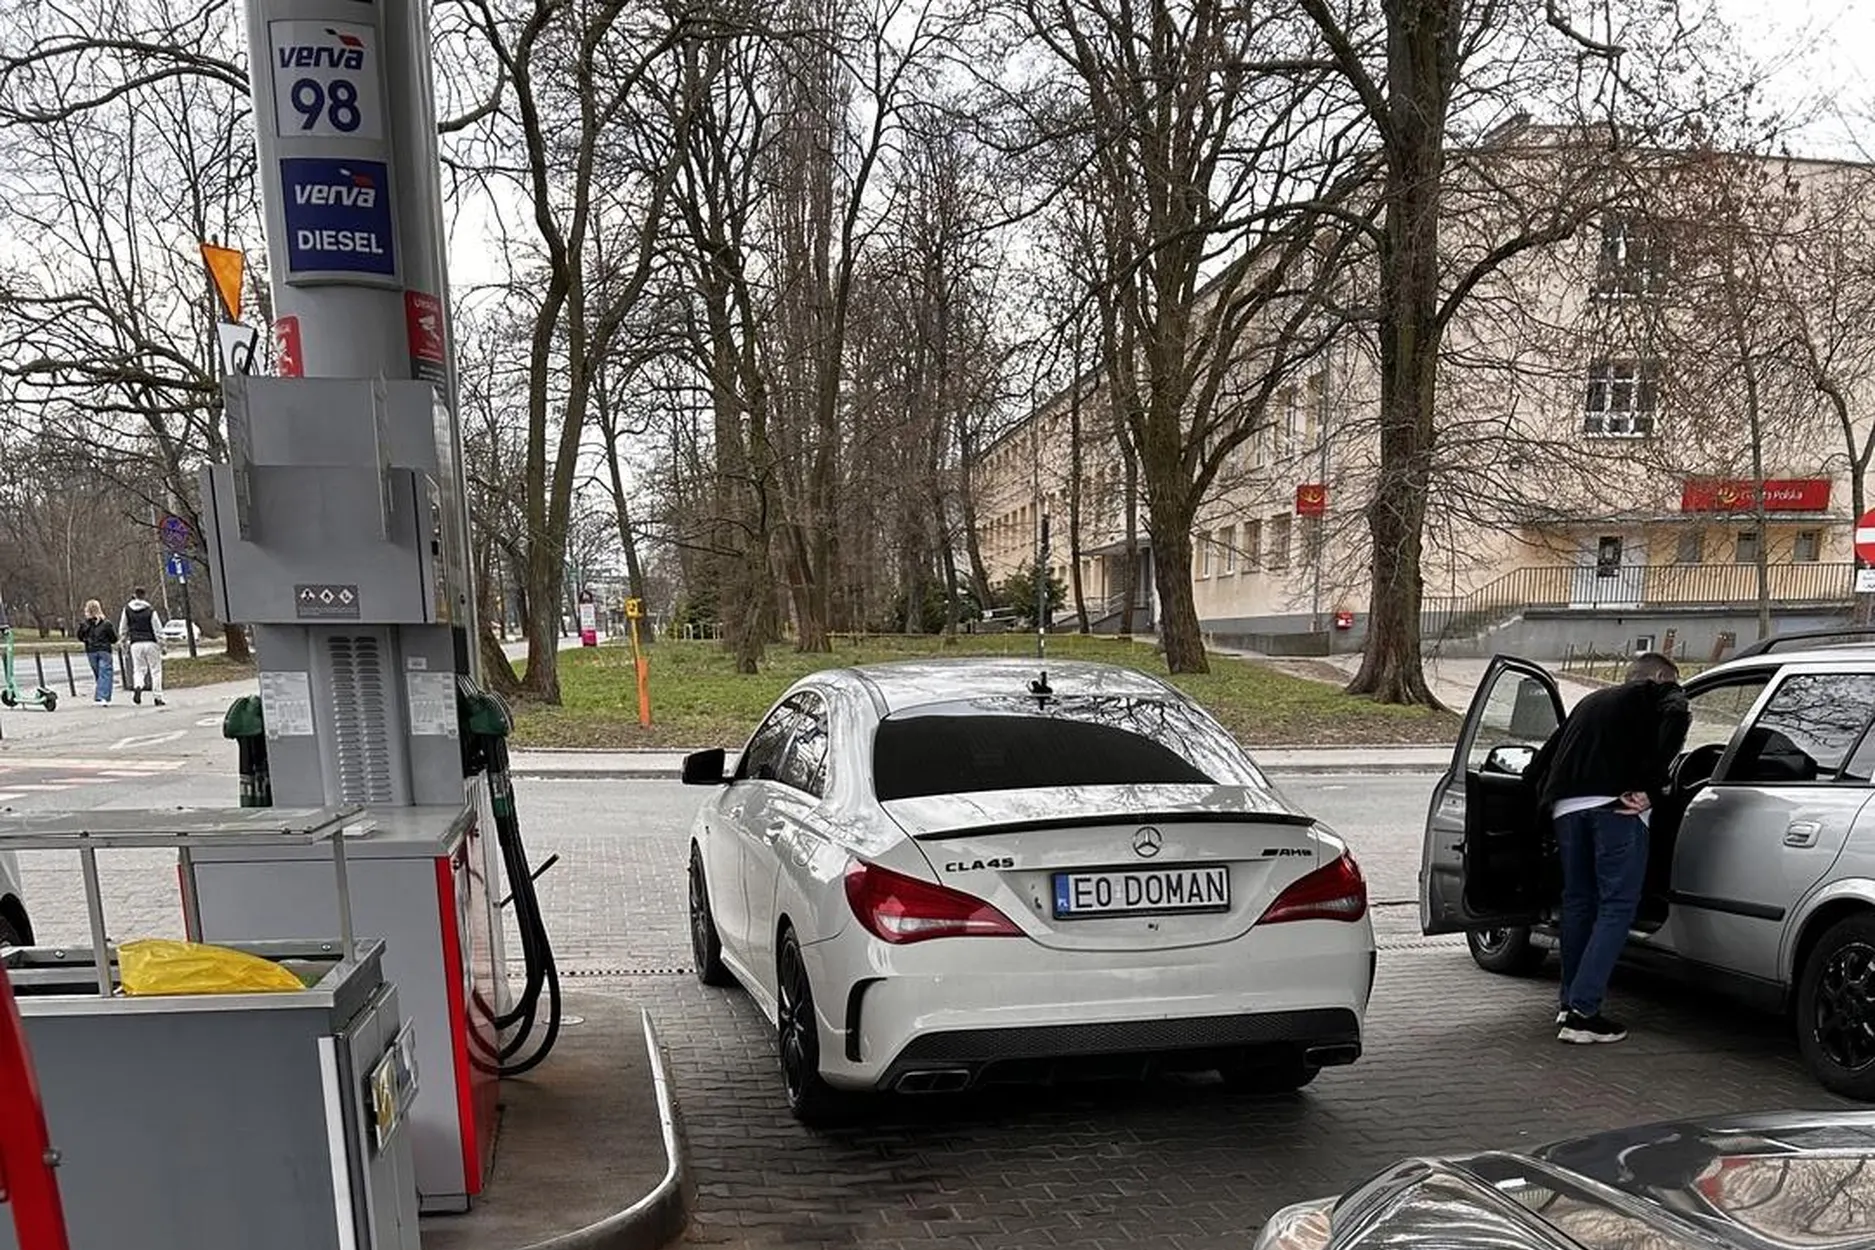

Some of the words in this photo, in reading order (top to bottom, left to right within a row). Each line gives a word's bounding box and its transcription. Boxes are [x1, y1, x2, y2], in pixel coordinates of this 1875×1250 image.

[278, 46, 364, 70] verva
[290, 78, 361, 132] 98
[294, 184, 376, 208] verva
[297, 230, 383, 253] DIESEL
[945, 857, 1015, 872] CLA45
[1124, 871, 1225, 906] DOMAN
